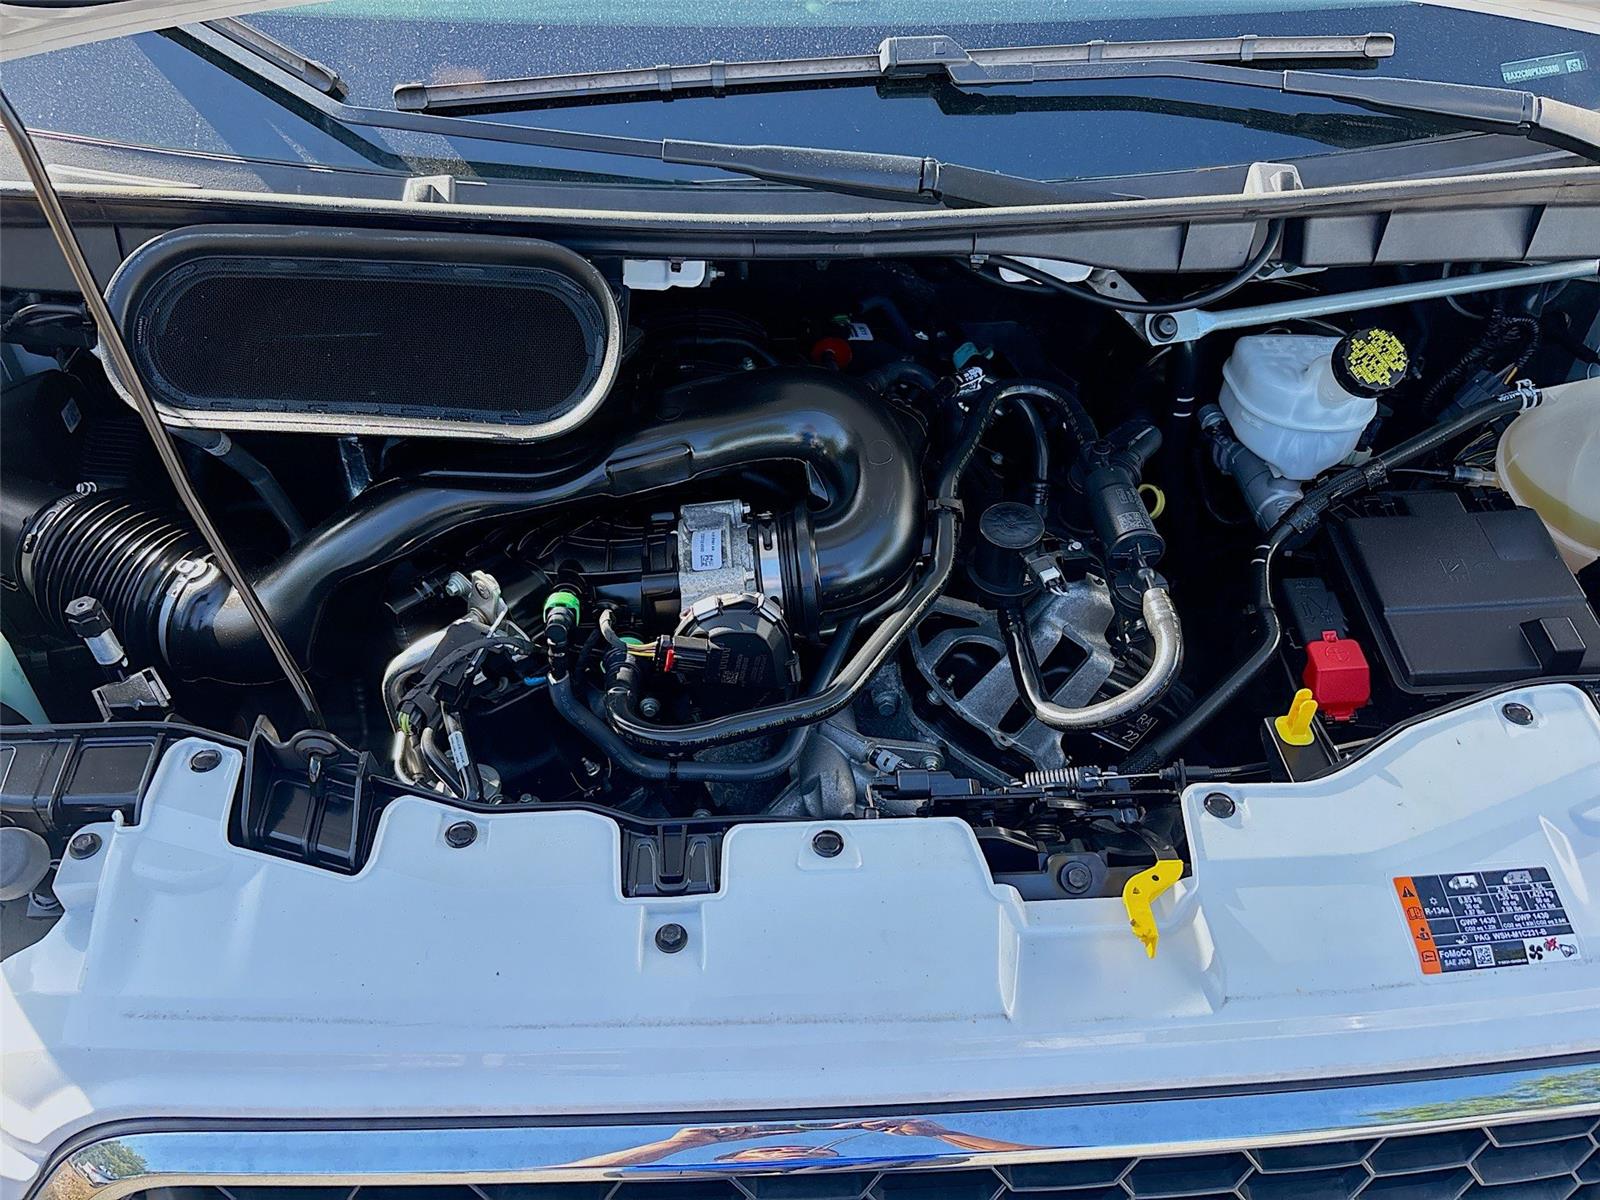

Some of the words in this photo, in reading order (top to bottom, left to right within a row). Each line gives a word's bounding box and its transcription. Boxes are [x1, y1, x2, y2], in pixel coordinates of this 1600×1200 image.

[1510, 892, 1520, 902] kg
[1546, 890, 1554, 898] kg
[1473, 896, 1482, 904] kg
[1424, 907, 1450, 915] R-134a
[1460, 918, 1478, 926] GWP
[1479, 916, 1496, 925] 1430
[1513, 913, 1532, 922] GWP
[1532, 912, 1550, 920] 1430
[1474, 933, 1491, 942] PAG
[1492, 929, 1547, 941] WSH-M1C231-B
[1438, 950, 1472, 959] FoMoCo
